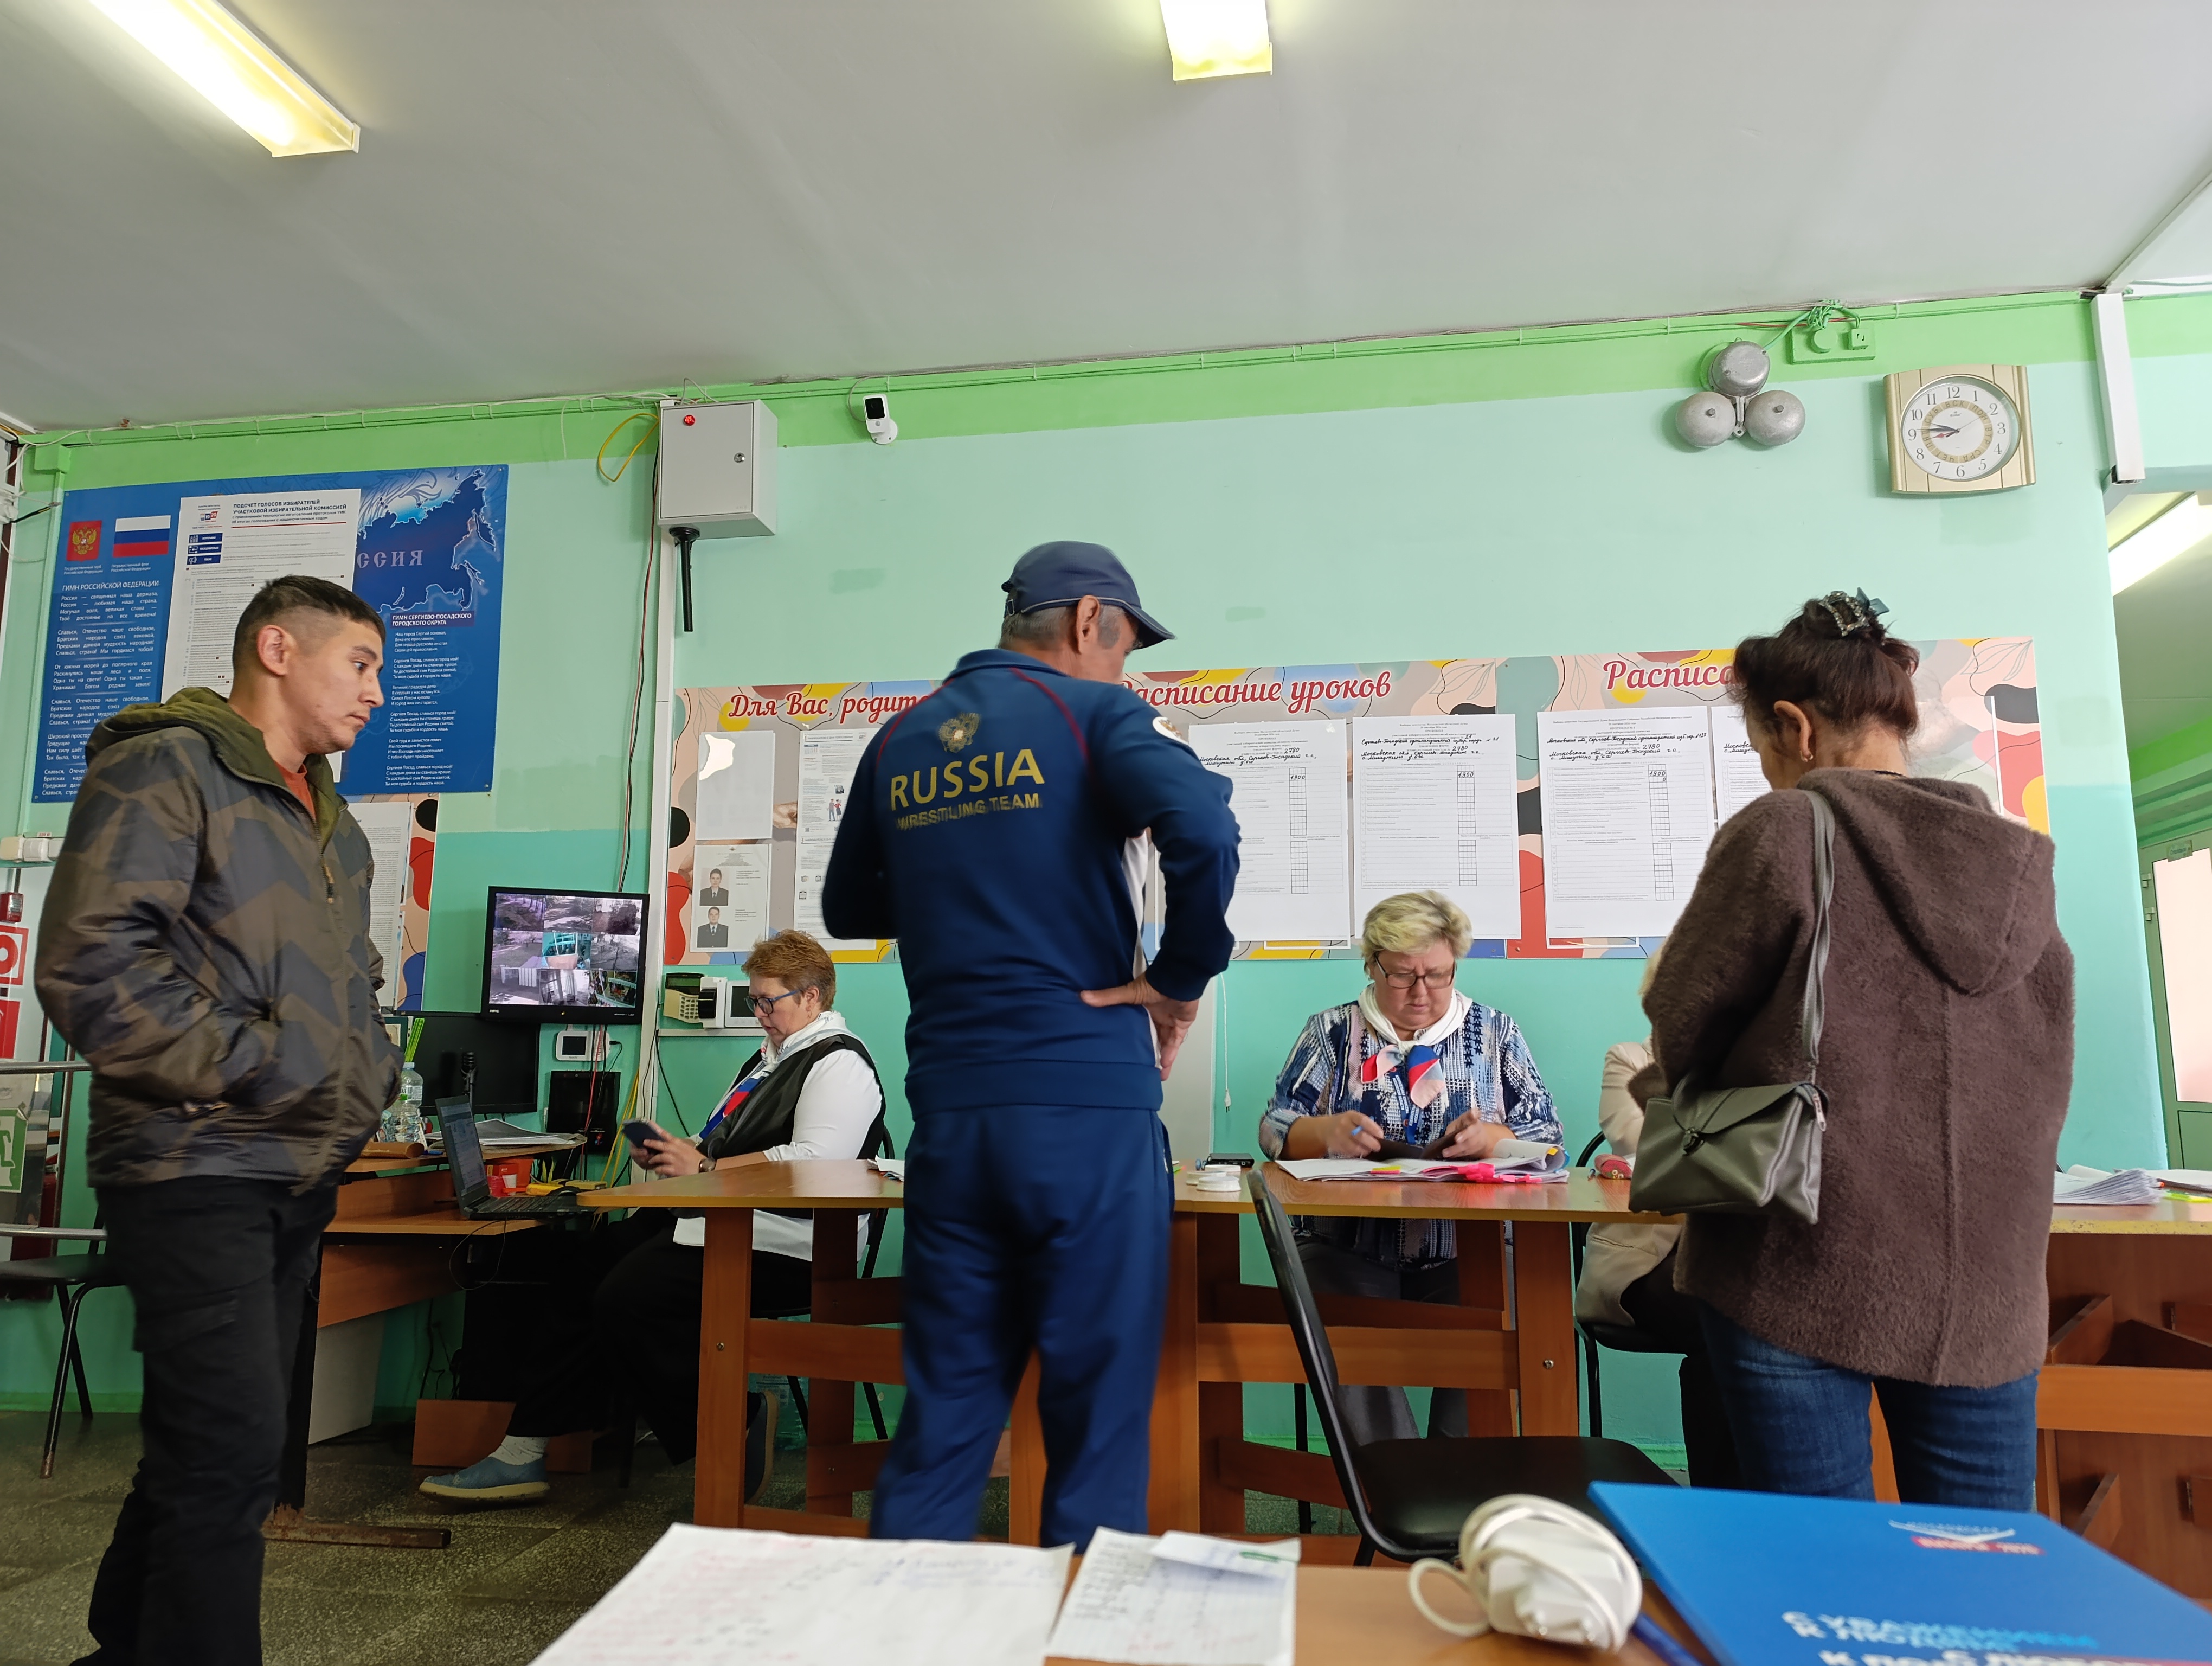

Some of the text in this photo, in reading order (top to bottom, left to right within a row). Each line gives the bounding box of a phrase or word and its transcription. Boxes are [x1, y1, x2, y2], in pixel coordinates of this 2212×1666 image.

[1926, 393, 1936, 405] 11
[1947, 386, 1960, 399] 12
[1973, 390, 1977, 402] 1
[1911, 408, 1923, 421] 10
[1924, 408, 1939, 423] СУБ
[1973, 405, 1989, 421] ПОН
[1989, 403, 1998, 415] 2
[1908, 428, 1917, 441] 9
[1997, 422, 2006, 434] 3
[1917, 448, 1924, 460] 8
[1994, 443, 2002, 454] 4
[1935, 451, 1954, 462] ЧЕТ
[1962, 449, 1982, 462] СРД
[1933, 462, 1941, 473] 7
[1956, 465, 1965, 477] 6
[1978, 459, 1986, 470] 5
[357, 550, 423, 568] ССИЯ
[81, 582, 121, 590] РОССИЙСКОЙ
[1603, 661, 1734, 689] Расписа
[1288, 671, 1391, 714] уроков
[729, 694, 777, 717] Для
[786, 692, 833, 717] Вас,
[891, 749, 1045, 811] RUSSIA
[897, 793, 1041, 830] WRESTLING TEAM
